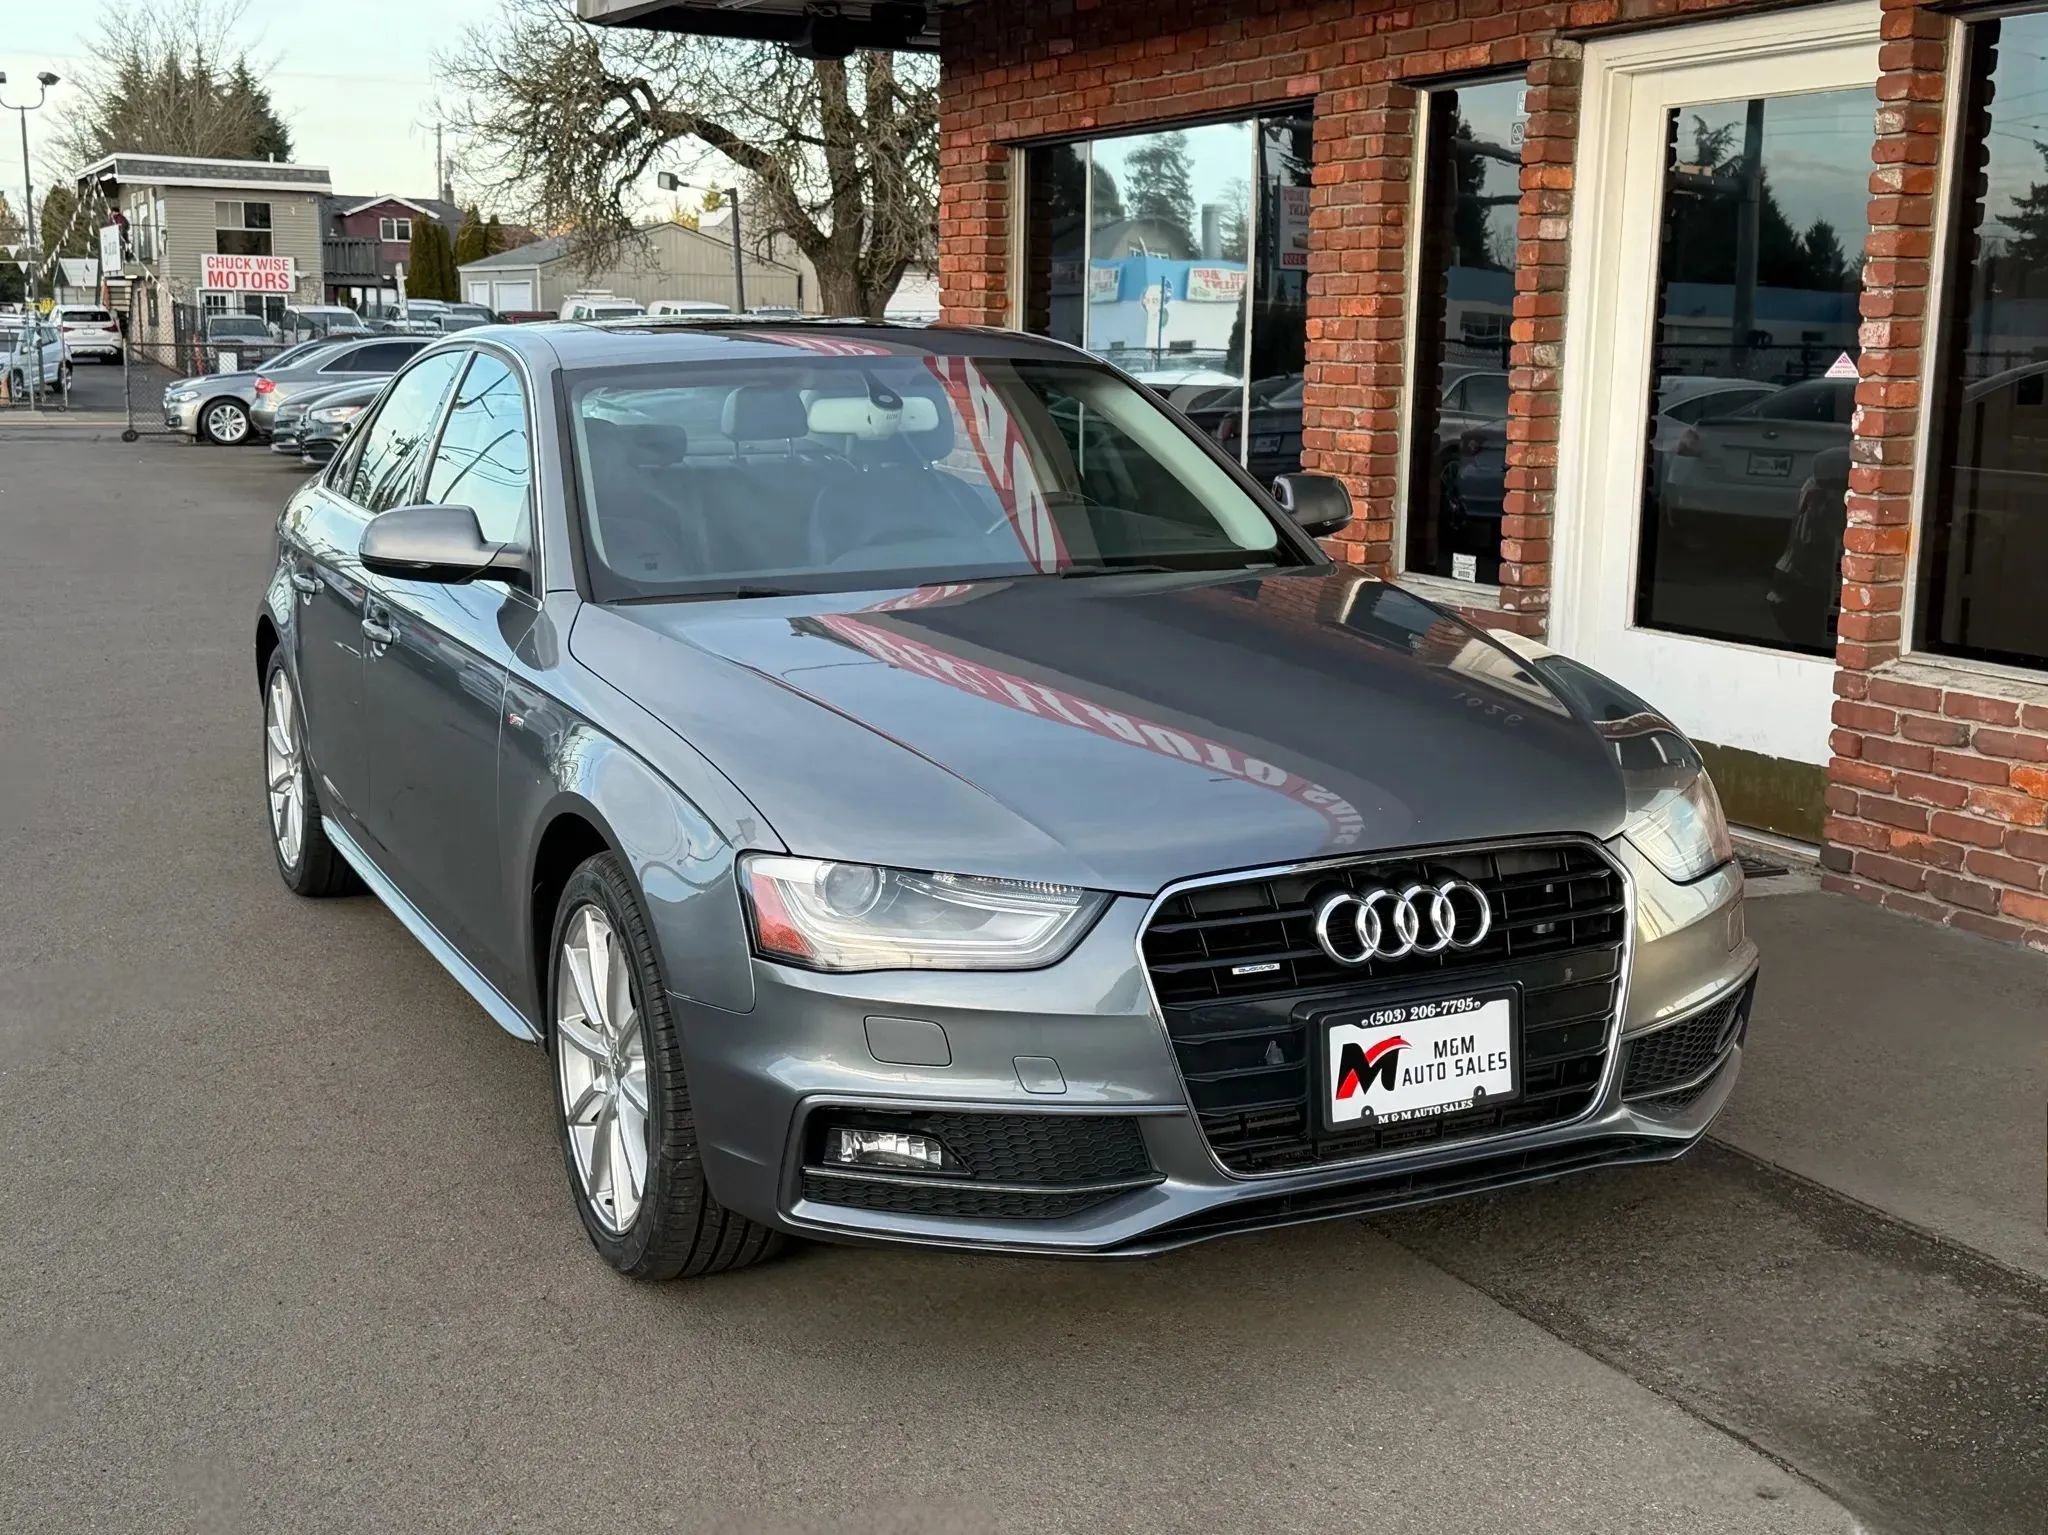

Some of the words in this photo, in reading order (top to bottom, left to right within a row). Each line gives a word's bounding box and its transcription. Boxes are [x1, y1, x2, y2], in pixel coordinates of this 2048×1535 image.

[207, 255, 252, 270] CHUCK
[256, 258, 289, 271] WISE
[207, 271, 289, 289] MOTORS
[1369, 1008, 1406, 1026] (503)
[1410, 997, 1473, 1020] 206-7795
[1433, 1035, 1475, 1059] M&M
[1402, 1061, 1446, 1087] AUTO
[1455, 1051, 1507, 1078] SALES
[1413, 1105, 1441, 1119] AUTO
[1443, 1099, 1474, 1113] SALES
